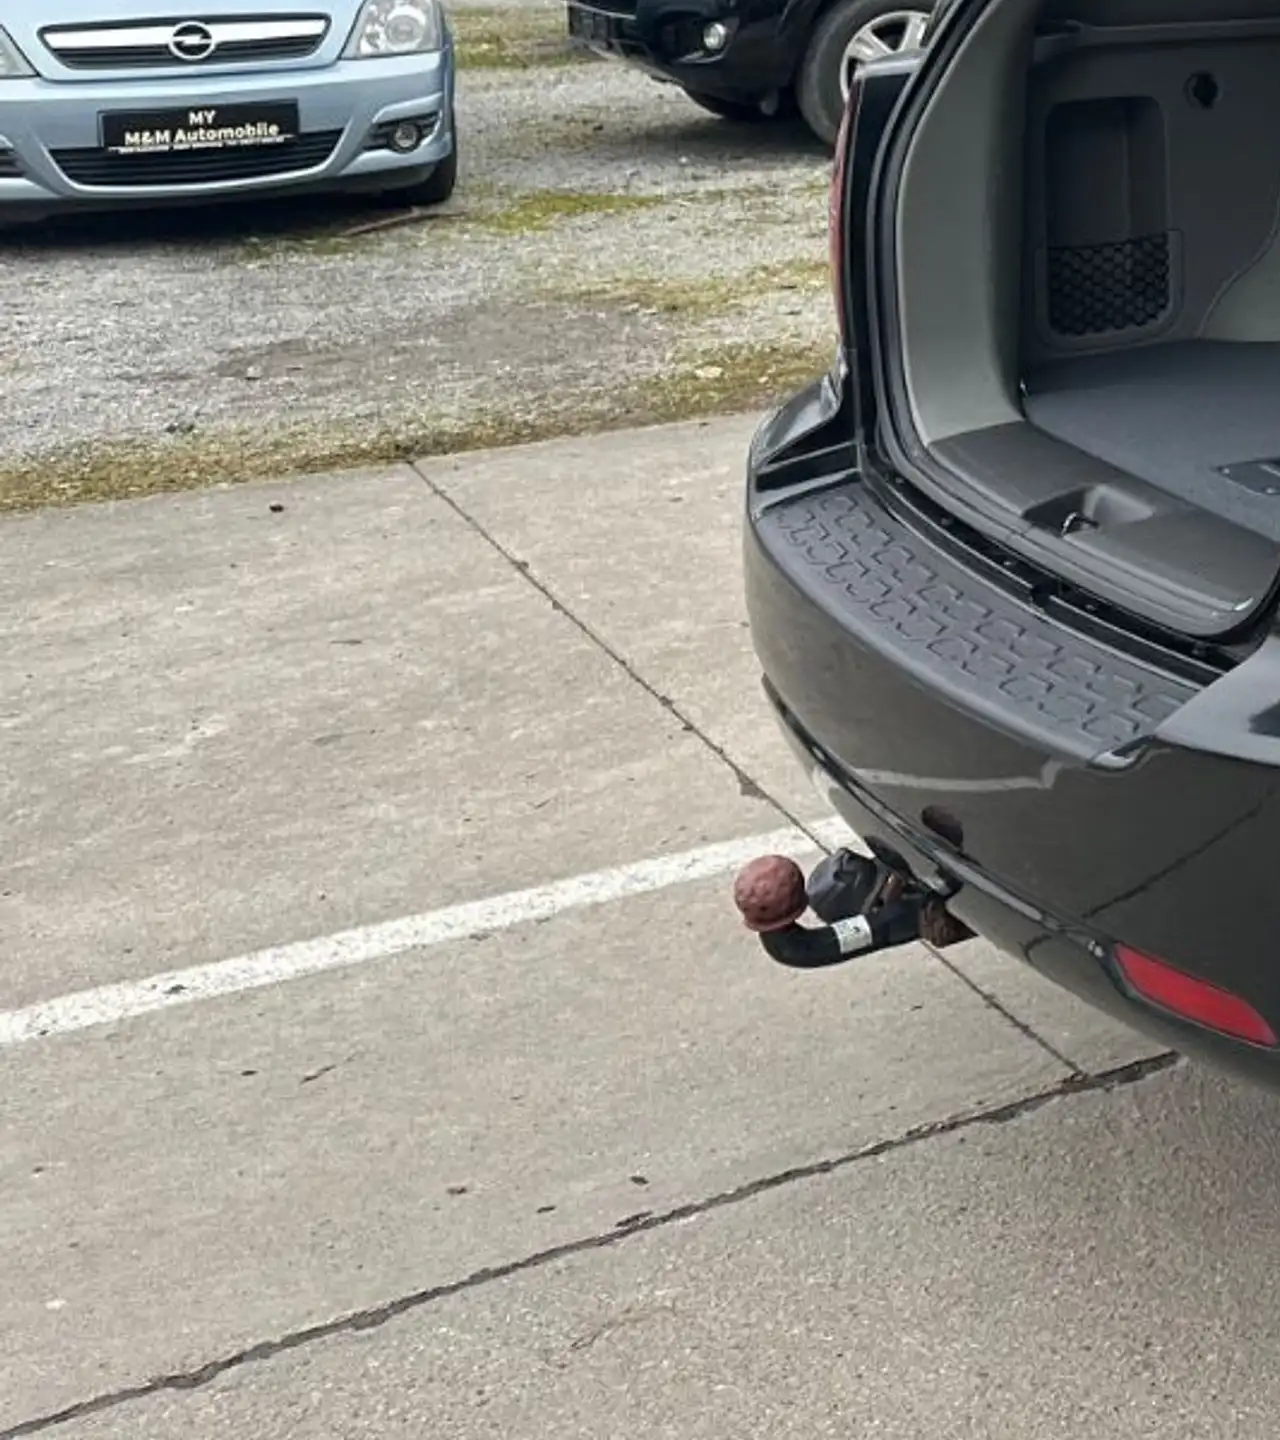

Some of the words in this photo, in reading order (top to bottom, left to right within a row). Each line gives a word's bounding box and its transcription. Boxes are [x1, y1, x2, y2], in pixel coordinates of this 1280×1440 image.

[188, 109, 217, 126] MY
[124, 130, 172, 146] M&M
[174, 121, 281, 143] Automobile
